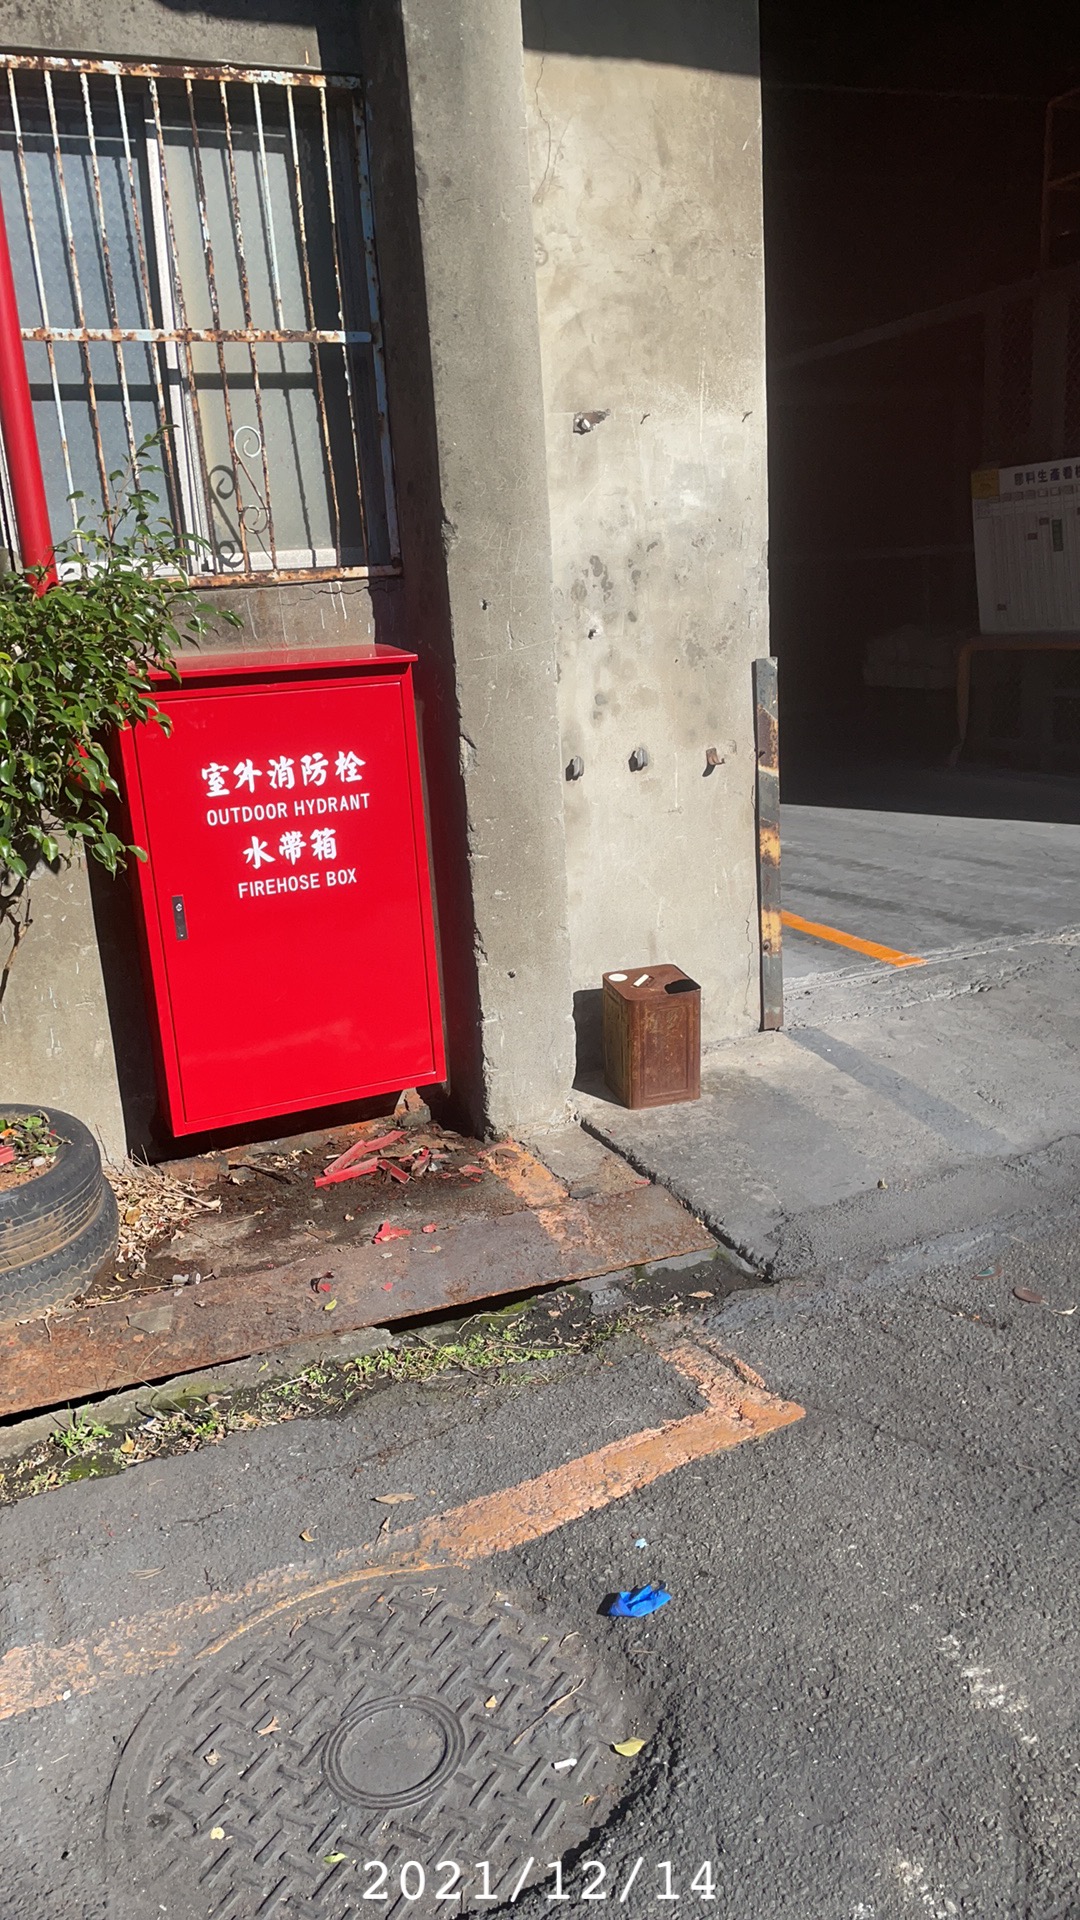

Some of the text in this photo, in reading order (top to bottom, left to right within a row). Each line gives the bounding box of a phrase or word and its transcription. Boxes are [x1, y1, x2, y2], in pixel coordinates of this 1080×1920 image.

[201, 750, 367, 798] 室外消防栓
[206, 792, 370, 826] OUTDOOR HYDRANT
[242, 827, 337, 870] 水帶箱
[238, 867, 357, 899] FIREHOSE BOX
